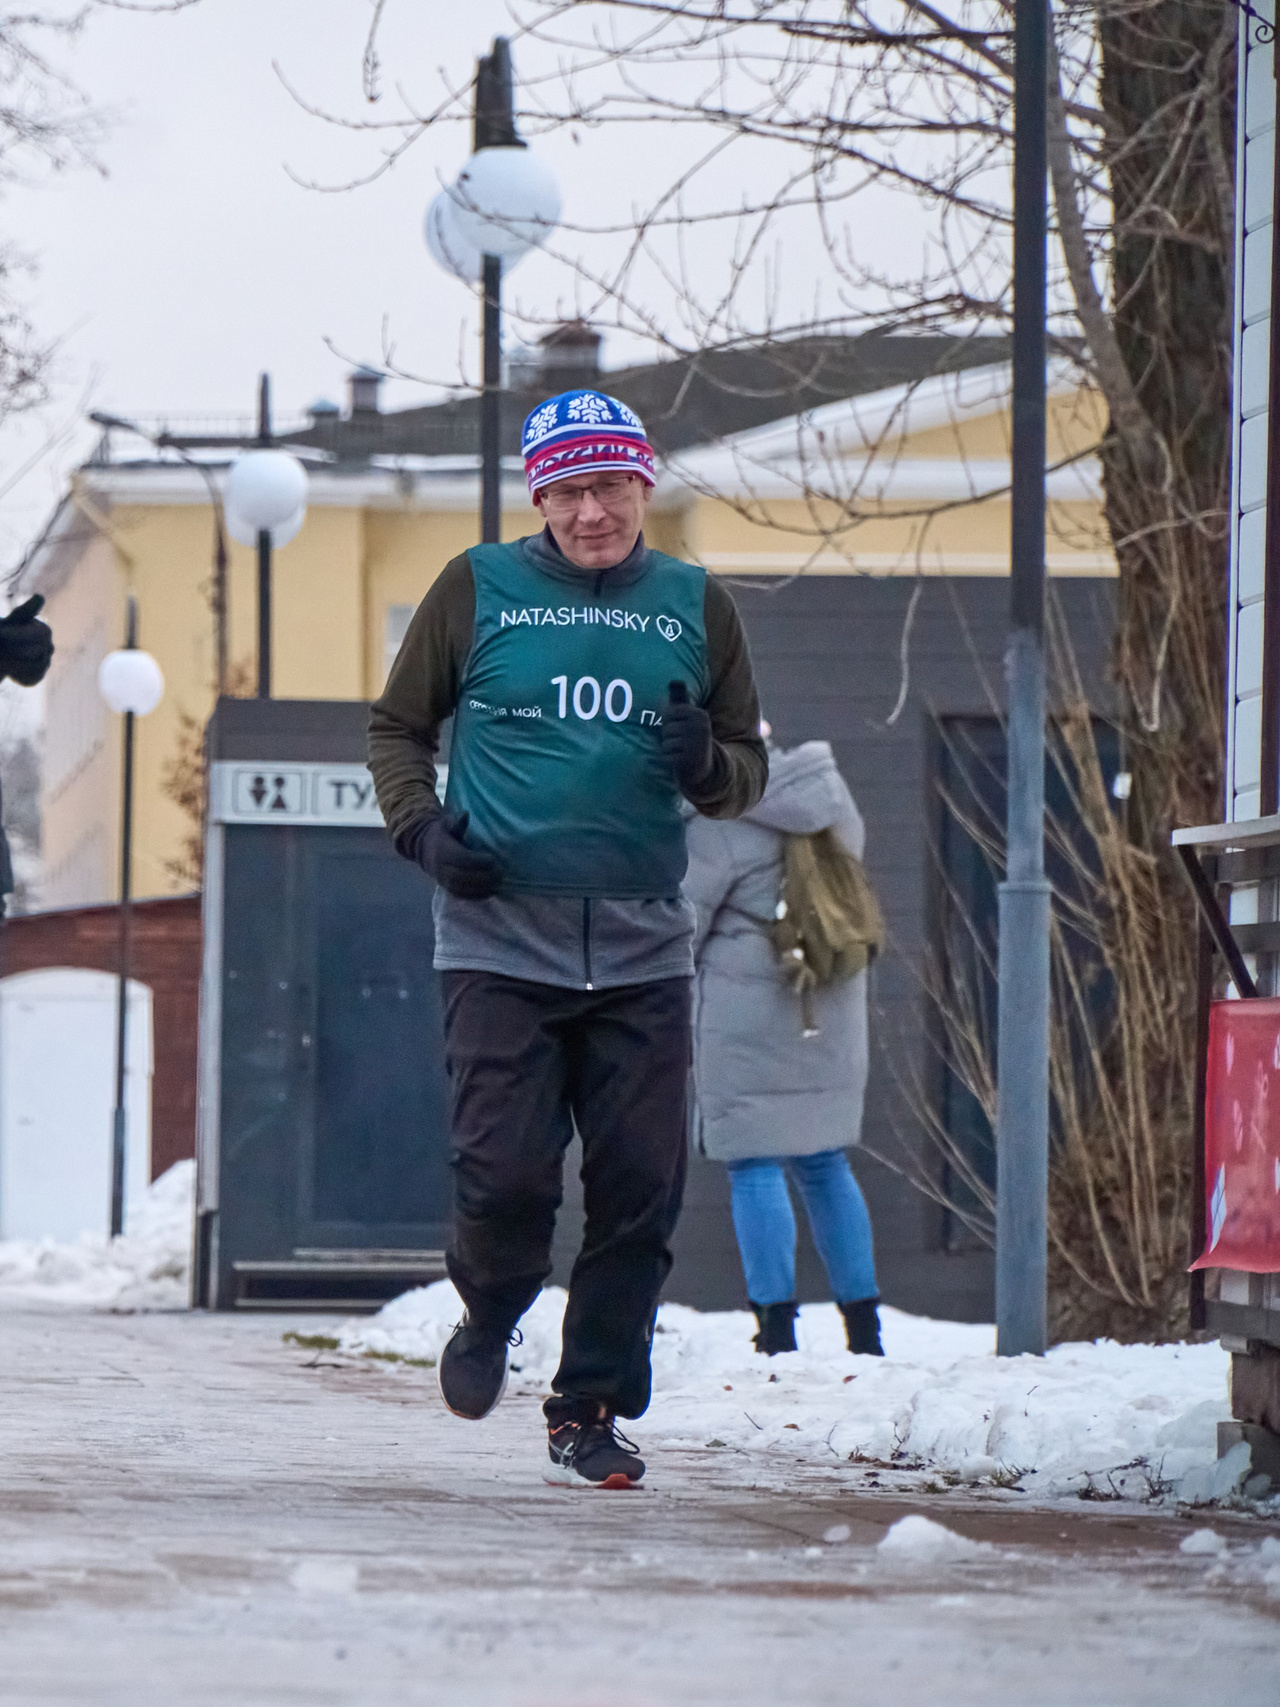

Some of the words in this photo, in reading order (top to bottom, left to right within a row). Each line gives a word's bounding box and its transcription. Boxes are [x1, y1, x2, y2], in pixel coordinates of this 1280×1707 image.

[500, 606, 650, 632] NATASHINSKY
[551, 674, 633, 723] 100
[328, 780, 380, 810] ТУ
